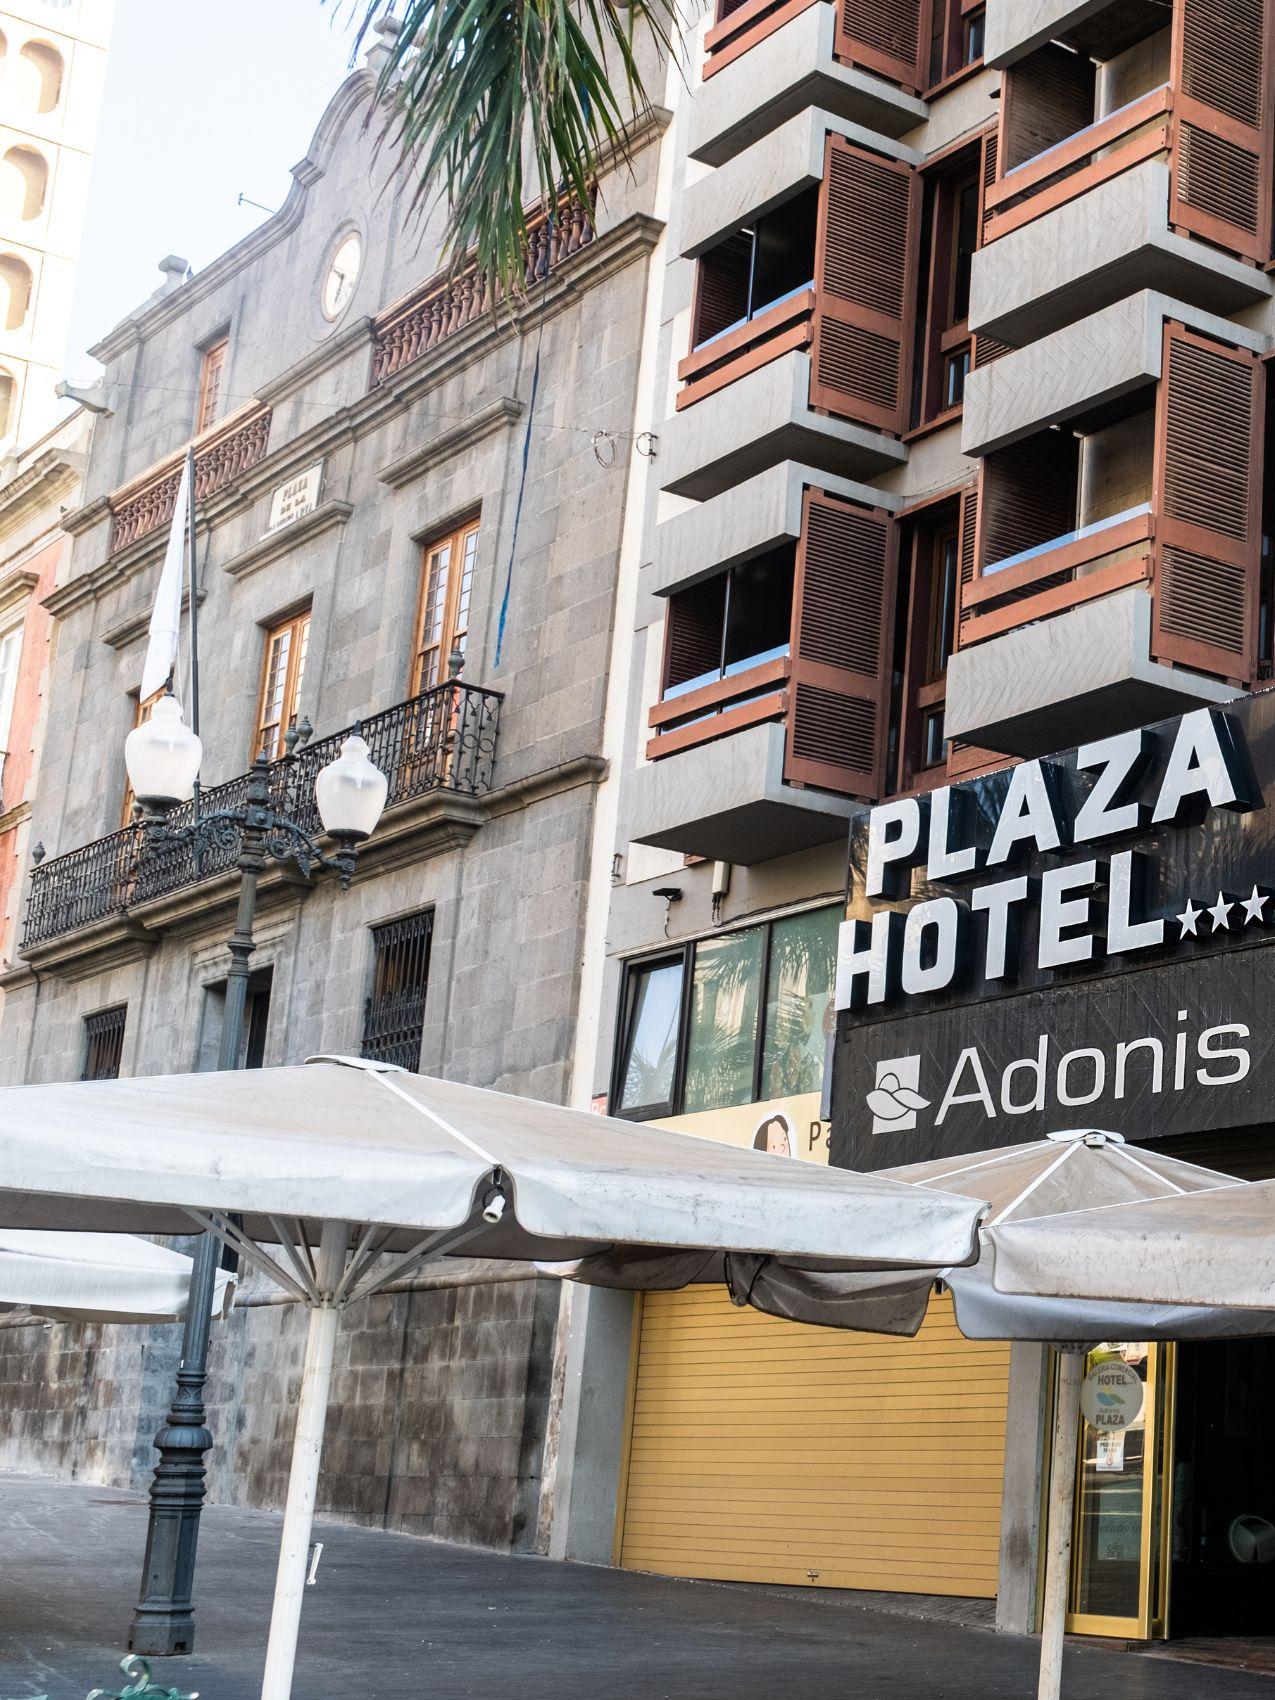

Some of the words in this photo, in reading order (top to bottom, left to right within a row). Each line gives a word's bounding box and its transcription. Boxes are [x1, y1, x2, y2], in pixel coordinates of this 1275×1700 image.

[865, 707, 1237, 897] PLAZA
[834, 849, 1164, 1012] HOTEL
[934, 1009, 1251, 1126] Adonis
[1095, 1414, 1125, 1426] PLAZA
